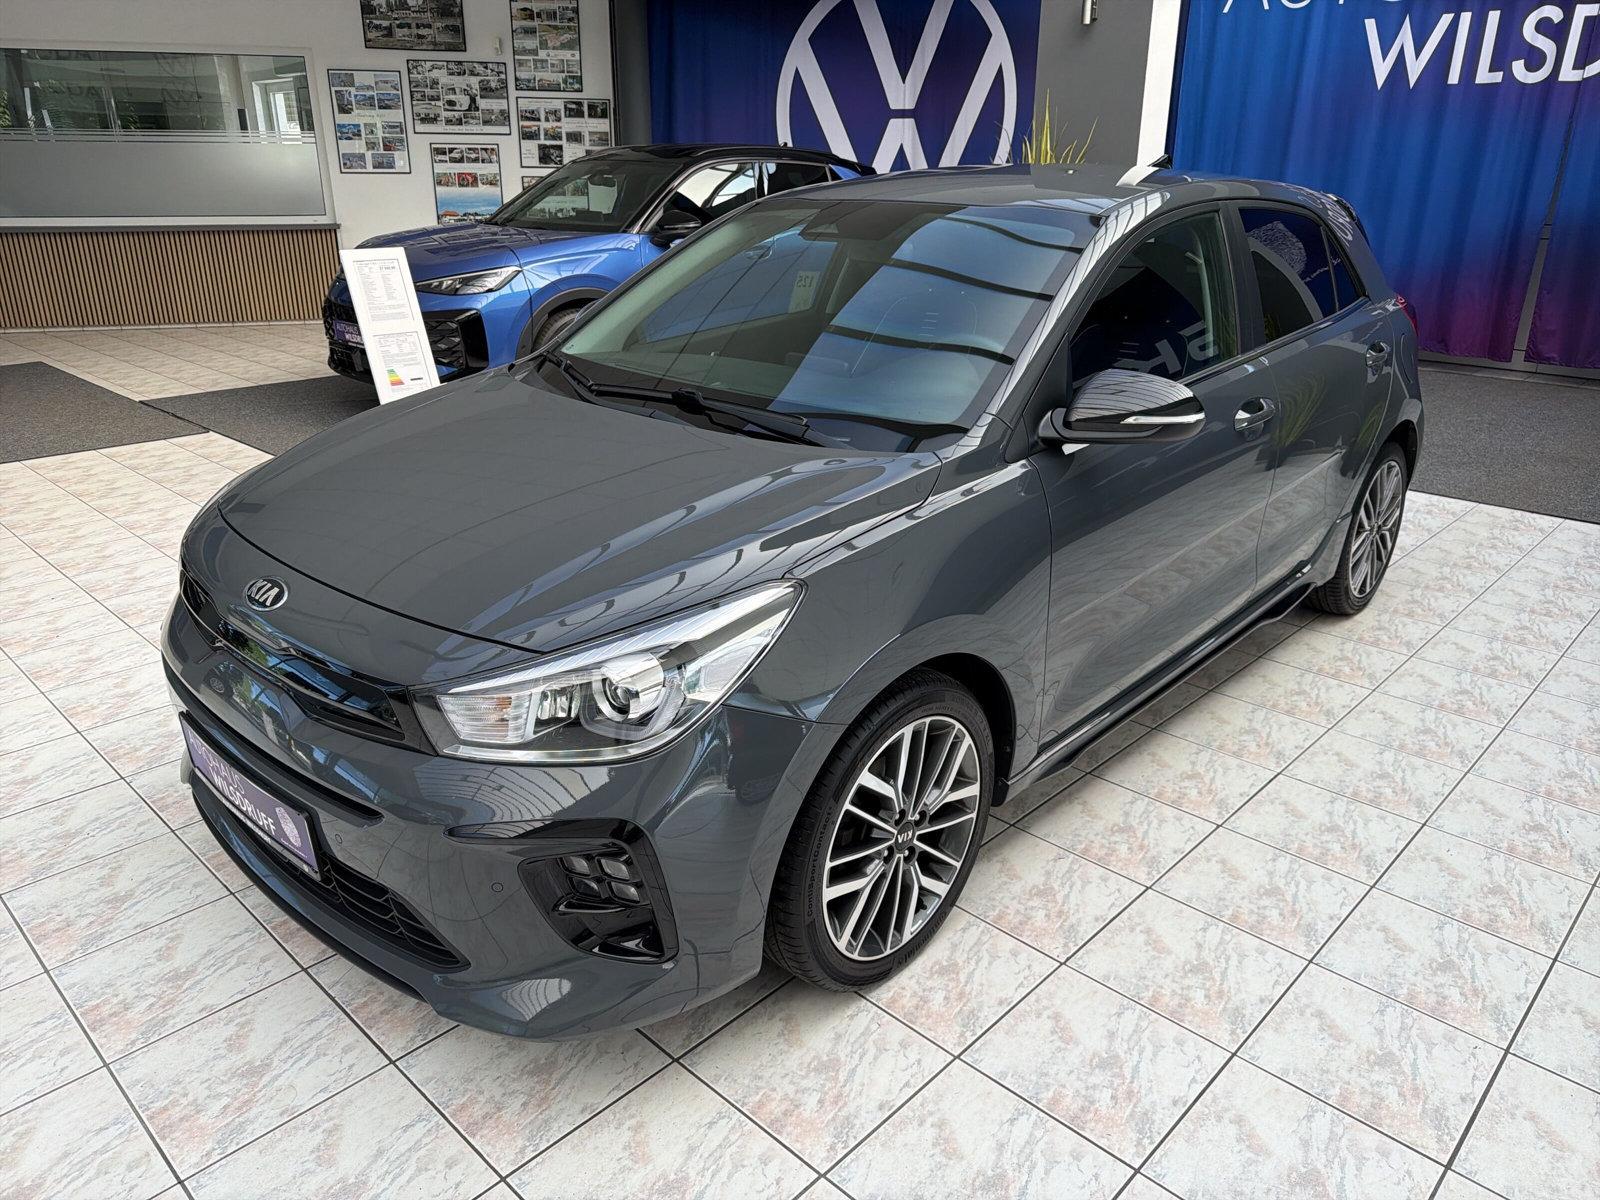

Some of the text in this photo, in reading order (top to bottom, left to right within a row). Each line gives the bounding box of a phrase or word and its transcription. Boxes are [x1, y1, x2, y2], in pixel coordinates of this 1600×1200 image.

[247, 579, 281, 607] KIA
[187, 729, 245, 795] AUTOHAUS
[209, 766, 276, 836] WILSDRUFF
[897, 829, 913, 843] KIA
